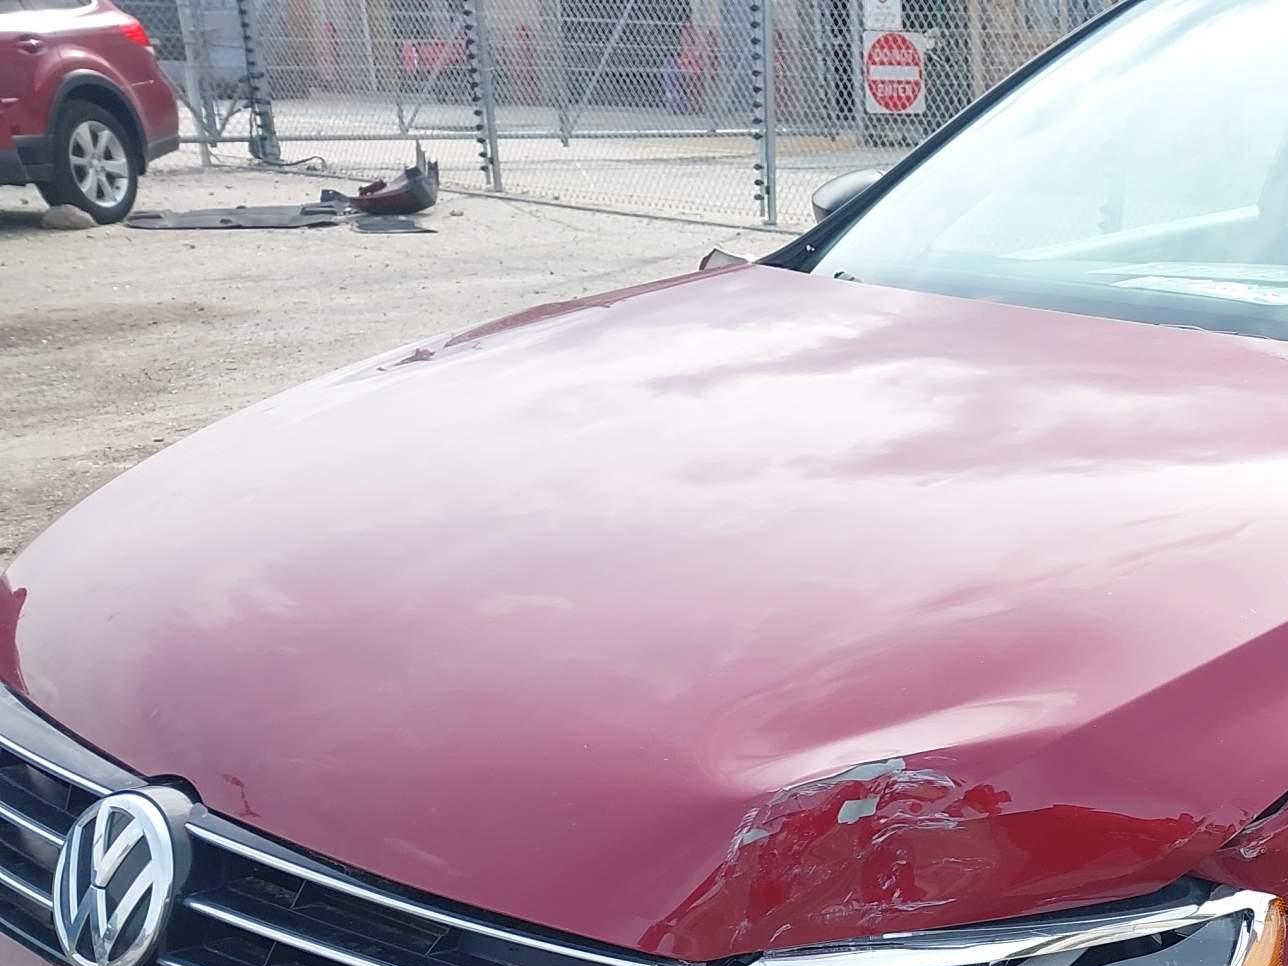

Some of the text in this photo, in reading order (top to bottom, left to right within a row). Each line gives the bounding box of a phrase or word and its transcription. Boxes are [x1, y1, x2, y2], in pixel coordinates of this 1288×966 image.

[875, 48, 913, 60] DO NOT
[878, 84, 912, 96] ENTER
